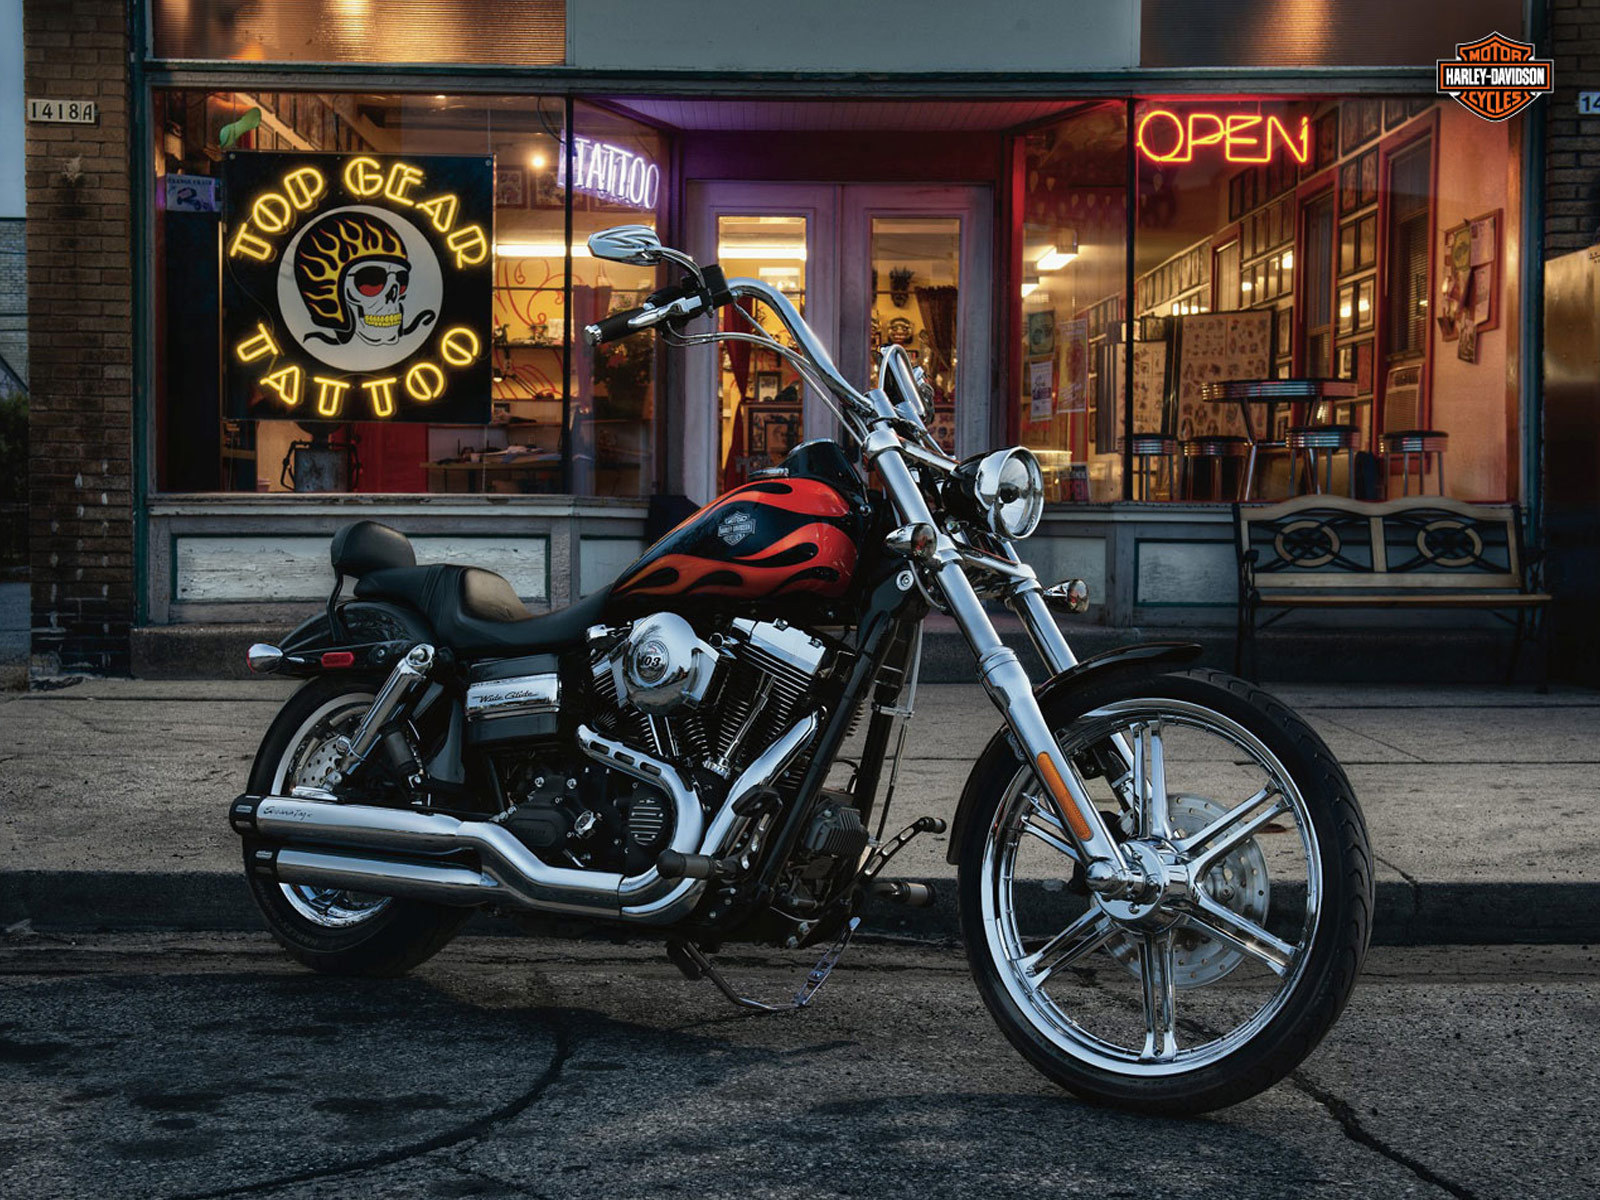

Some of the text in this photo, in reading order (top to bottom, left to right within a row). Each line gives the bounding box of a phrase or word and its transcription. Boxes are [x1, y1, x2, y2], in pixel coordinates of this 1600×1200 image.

[32, 102, 93, 121] 1418A
[1136, 110, 1309, 163] OPEN
[574, 137, 660, 210] TATTOO
[230, 156, 488, 269] TOP GEAR
[236, 322, 480, 417] TATTOO
